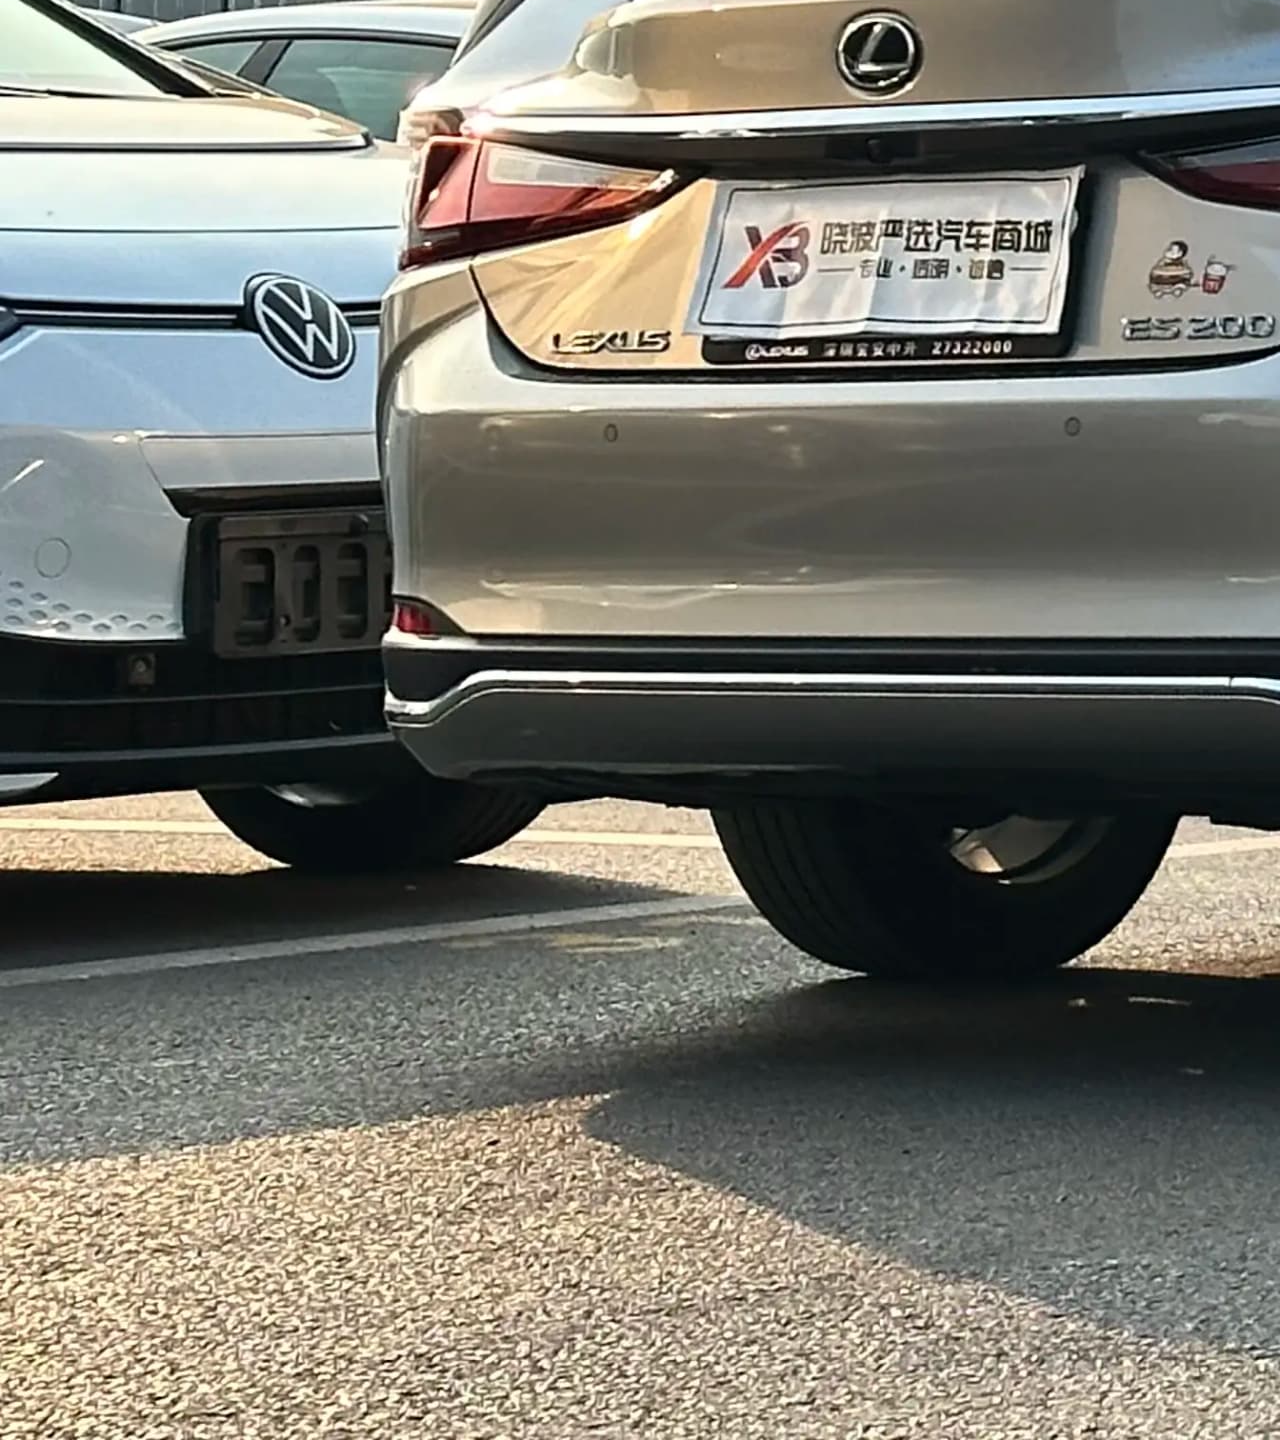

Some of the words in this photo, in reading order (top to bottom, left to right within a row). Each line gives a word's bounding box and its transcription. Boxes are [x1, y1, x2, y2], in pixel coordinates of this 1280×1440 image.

[819, 218, 1054, 256] 晓波严选汽车商城
[1120, 315, 1182, 341] ES
[1186, 313, 1276, 340] 200
[551, 329, 672, 355] LEXUS
